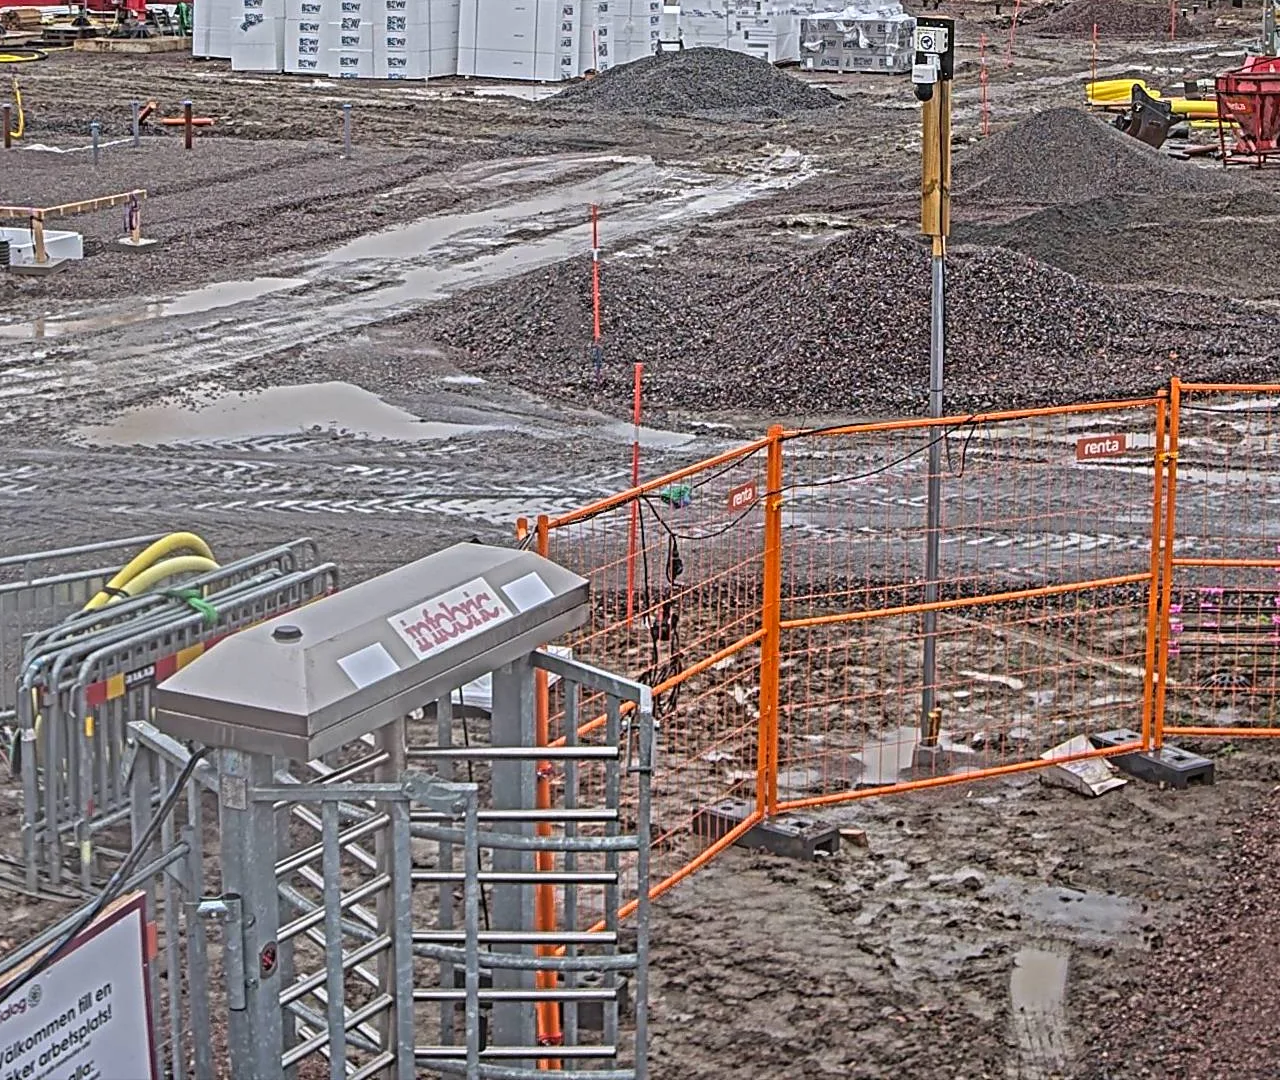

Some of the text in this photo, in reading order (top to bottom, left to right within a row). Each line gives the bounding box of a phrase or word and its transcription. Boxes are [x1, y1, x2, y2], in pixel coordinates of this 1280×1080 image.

[1084, 439, 1119, 455] renta
[733, 487, 753, 507] renta
[400, 591, 500, 653] infobric
[78, 993, 92, 1016] till
[95, 982, 112, 1002] en
[38, 1004, 112, 1067] arbetsplats!
